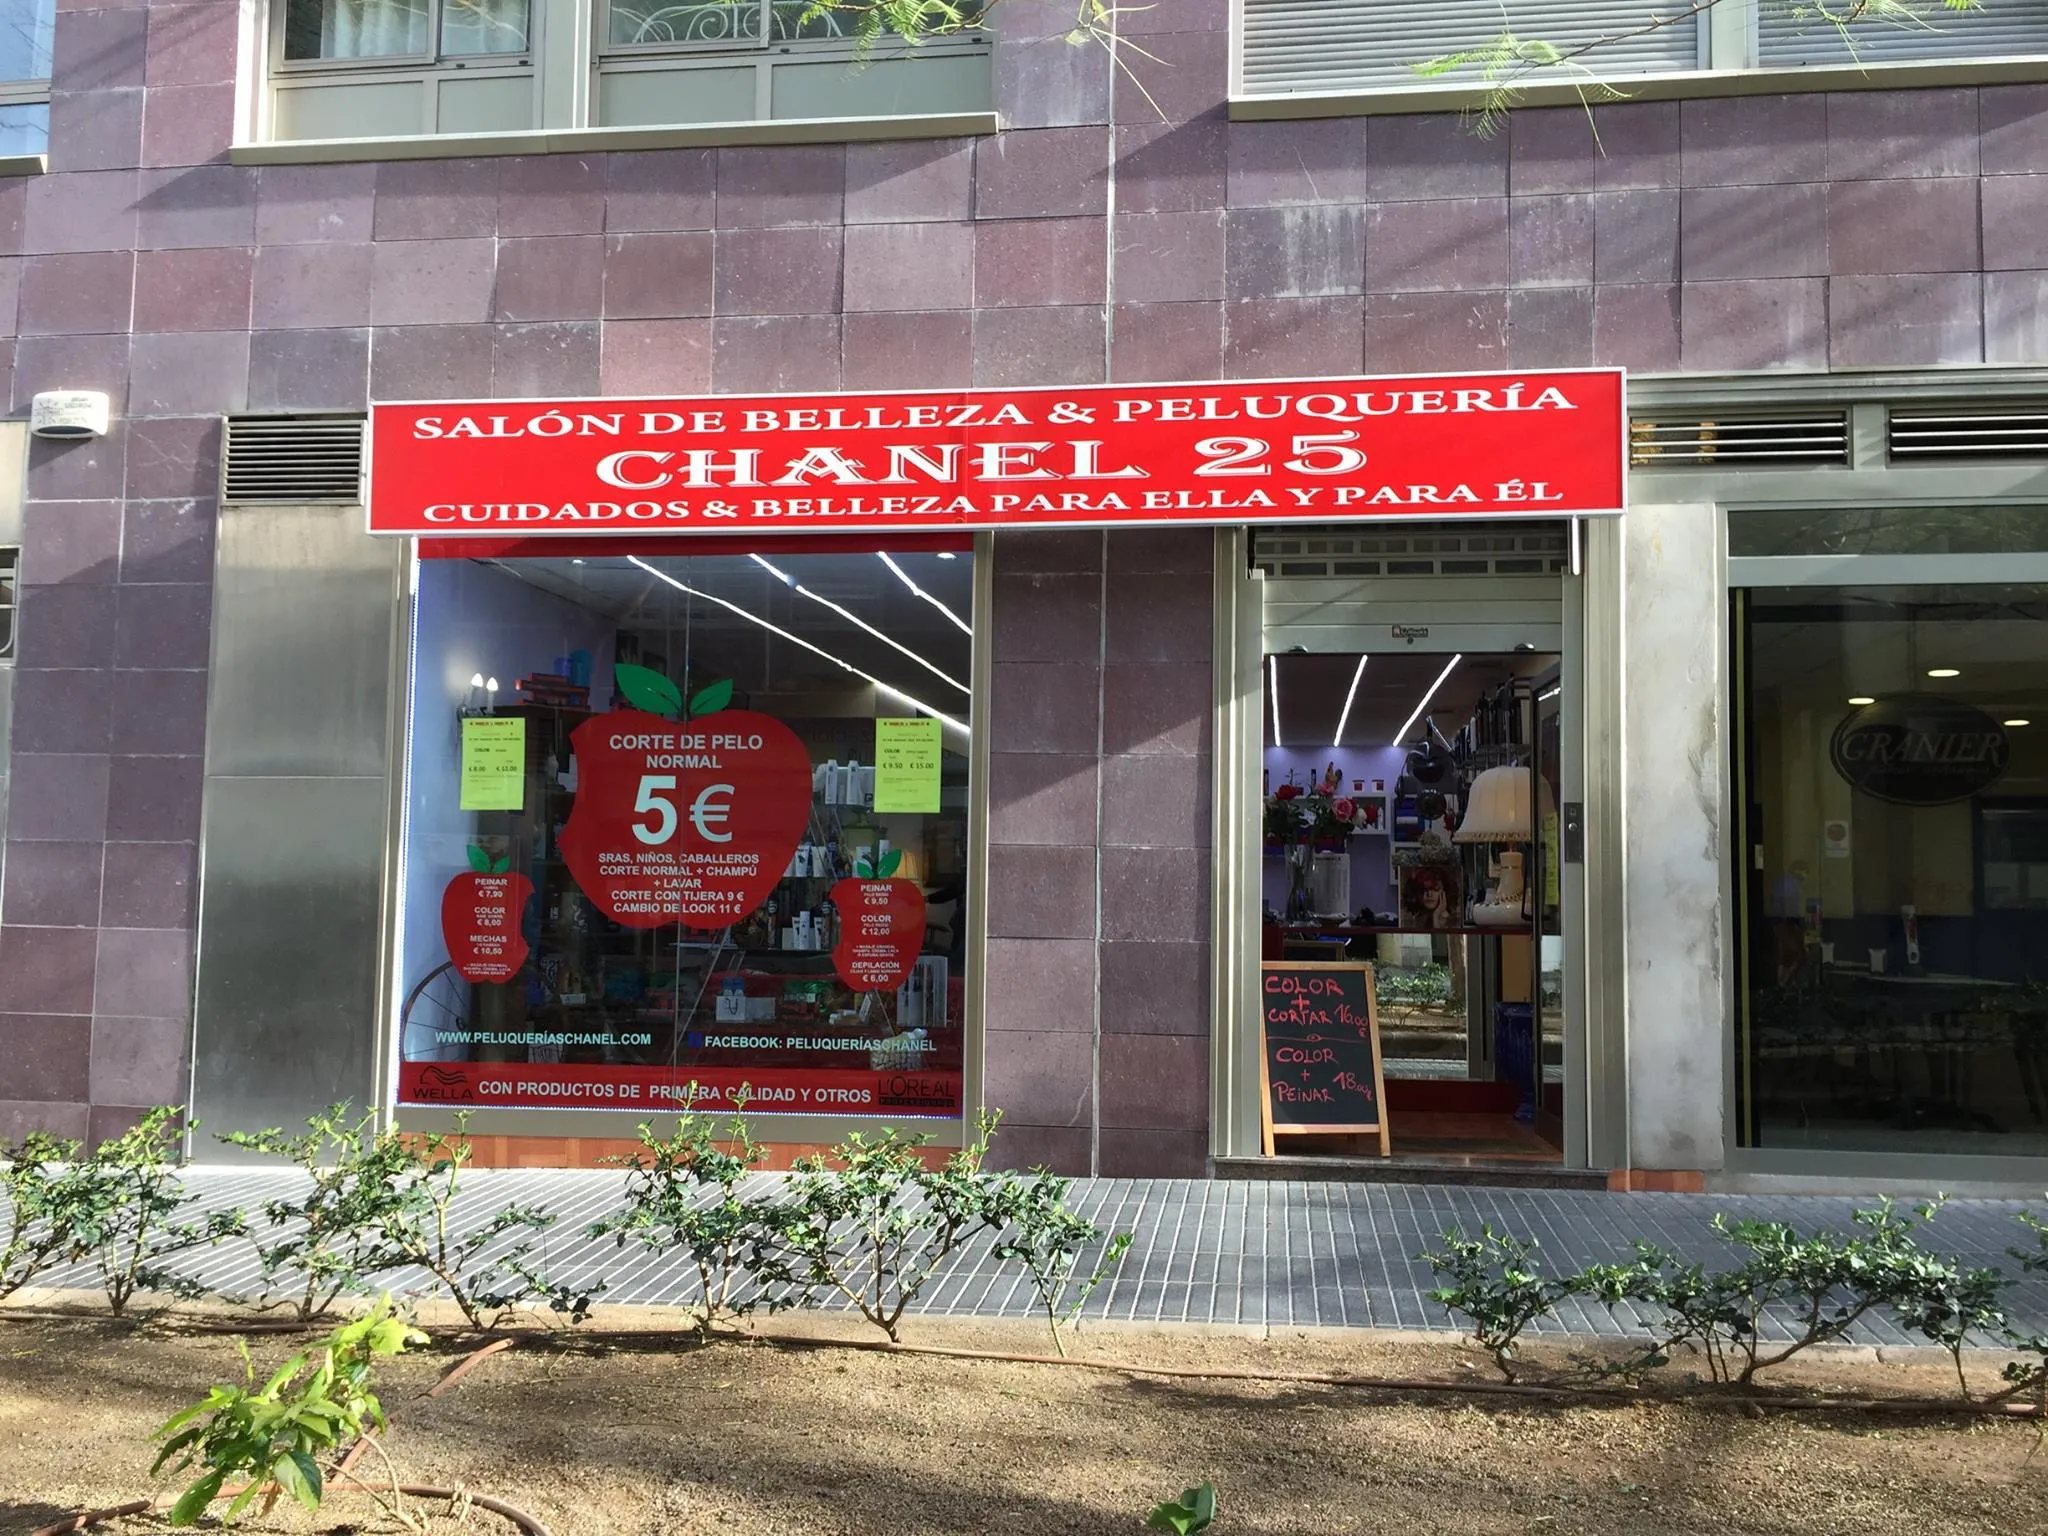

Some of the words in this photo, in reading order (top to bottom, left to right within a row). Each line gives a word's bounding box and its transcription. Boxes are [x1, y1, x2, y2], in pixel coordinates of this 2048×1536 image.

[413, 409, 626, 439] SALÓN
[638, 411, 728, 435] DE
[740, 403, 1034, 433] BELLEZA
[1047, 401, 1097, 425] &
[1112, 381, 1578, 423] PELUQUERÍA
[595, 438, 1151, 490] CHANEL
[1192, 429, 1368, 478] 25
[423, 500, 690, 523] CUIDADOS
[702, 500, 740, 517] &
[753, 494, 981, 517] BELLEZA
[989, 491, 1132, 512] PARA
[1142, 488, 1278, 509] ELLA
[1285, 487, 1324, 506] Y
[1333, 483, 1483, 505] PARA
[1492, 479, 1564, 502] ÉL
[609, 734, 675, 750] CORTE
[680, 735, 708, 750] DE
[711, 734, 763, 750] PELO
[1842, 731, 2003, 768] GRANIER
[646, 755, 722, 769] NORMAL
[631, 775, 678, 846] 5
[689, 783, 736, 843] €
[598, 853, 634, 865] SRAS,
[636, 852, 676, 865] NIÑOS,
[680, 853, 760, 865] CABALLEROS
[600, 865, 640, 876] CORTE
[643, 866, 693, 876] NORMAL
[696, 867, 704, 875] +
[706, 863, 757, 877] CHAMPÚ
[474, 878, 508, 886] PEINAR
[653, 879, 661, 887] +
[664, 878, 702, 889] LAVAR
[860, 884, 893, 892] PEINAR
[611, 890, 652, 901] CORTE
[654, 890, 681, 901] CON
[683, 890, 725, 901] TIJERA
[727, 891, 734, 901] 9
[737, 891, 745, 901] €
[474, 907, 506, 915] COLOR
[613, 902, 660, 913] CAMBIO
[665, 903, 680, 913] DE
[682, 902, 716, 914] LOOK
[720, 903, 731, 914] 11
[734, 903, 742, 914] €
[860, 914, 892, 923] COLOR
[470, 935, 507, 943] MECHAS
[852, 960, 900, 969] DEPILACIÓN
[1265, 975, 1344, 996] COLOR
[1268, 1007, 1332, 1026] CORTAR
[435, 1030, 652, 1045] WWW.PELUQUERÍASCHANEL.COM
[704, 1034, 783, 1049] FACEBOOK:
[786, 1036, 937, 1051] PELUQUERÍASCHANEL
[1276, 1047, 1338, 1064] COLOR
[414, 1087, 474, 1100] WELLA
[479, 1081, 513, 1095] CON
[517, 1081, 615, 1097] PRODUCTOS
[619, 1084, 640, 1098] DE
[799, 1088, 811, 1101] Y
[815, 1088, 871, 1103] OTROS
